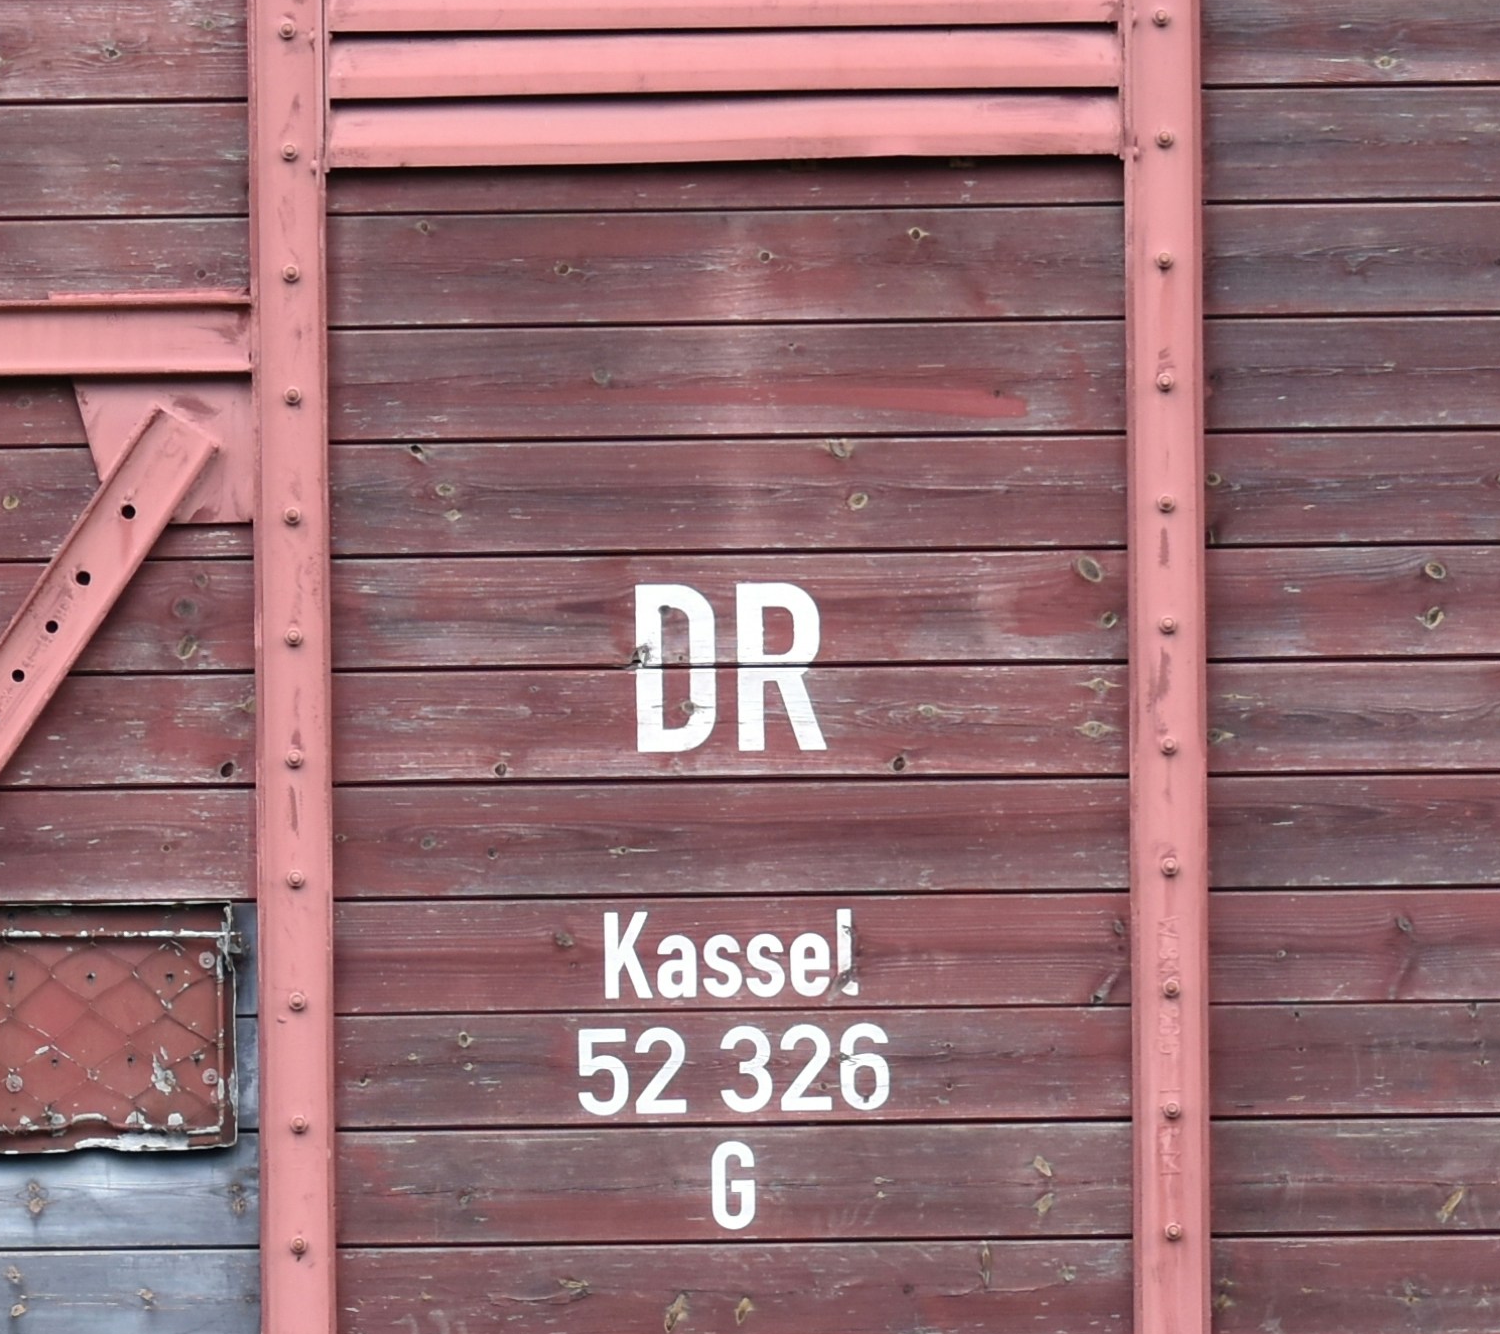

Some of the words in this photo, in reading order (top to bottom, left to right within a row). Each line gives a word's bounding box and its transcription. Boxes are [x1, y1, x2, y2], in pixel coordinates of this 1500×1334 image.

[634, 582, 828, 753] DR
[603, 908, 859, 1000] Kassel
[577, 1026, 688, 1116] 52
[720, 1023, 891, 1113] 326
[711, 1140, 756, 1231] G
